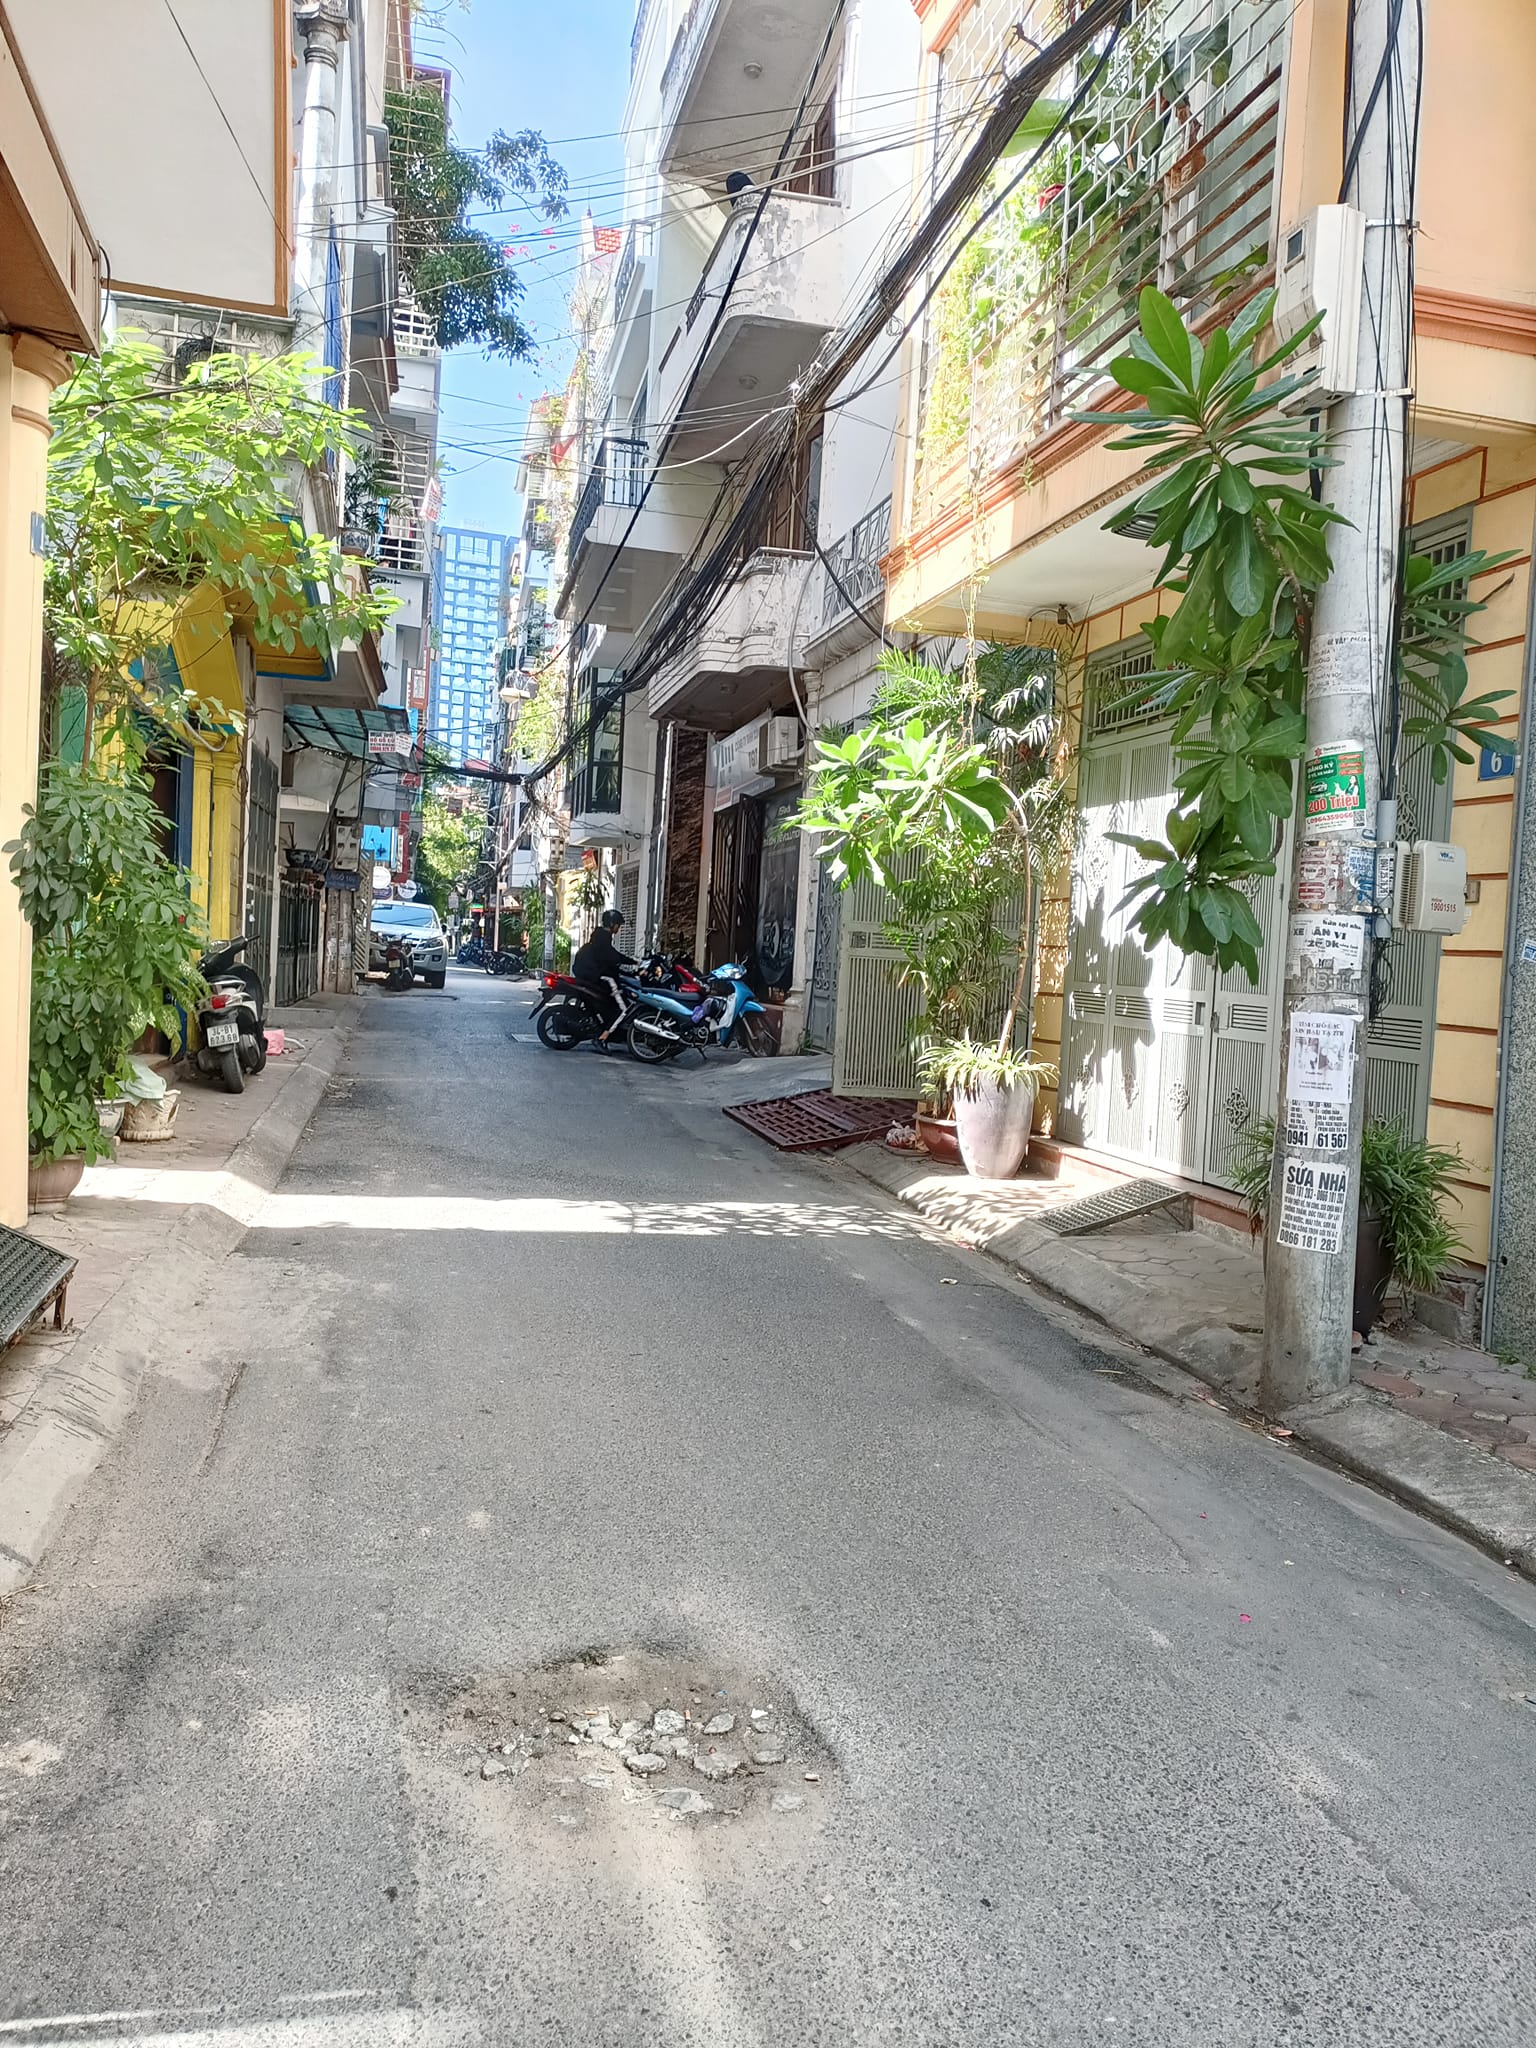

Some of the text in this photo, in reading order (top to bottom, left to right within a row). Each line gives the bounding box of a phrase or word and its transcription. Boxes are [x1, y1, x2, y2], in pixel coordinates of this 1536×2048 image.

[1490, 752, 1502, 773] 6
[1308, 798, 1326, 813] 200
[1431, 902, 1456, 912] 19001515
[1288, 1130, 1308, 1146] 0941
[1331, 1134, 1347, 1148] 567
[1287, 1161, 1346, 1192] SỬA NHÀ
[1302, 1235, 1317, 1249] 181
[1320, 1238, 1336, 1252] 283
